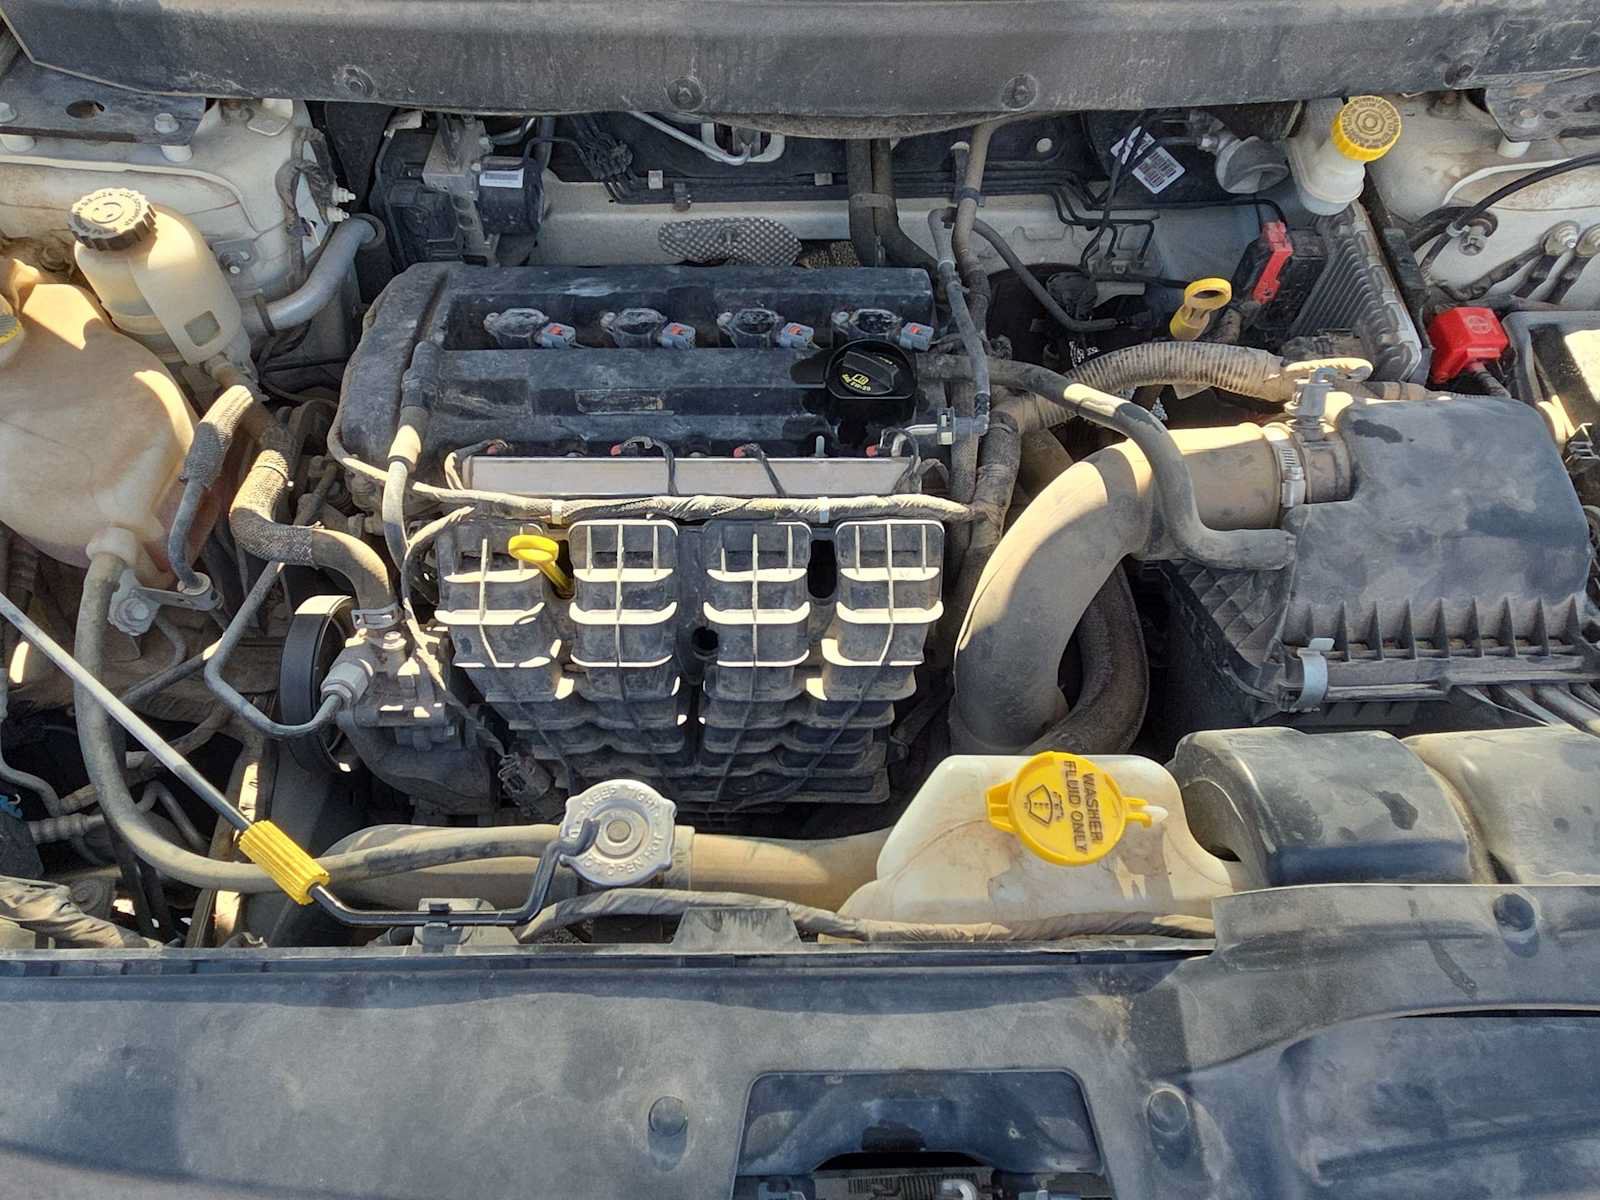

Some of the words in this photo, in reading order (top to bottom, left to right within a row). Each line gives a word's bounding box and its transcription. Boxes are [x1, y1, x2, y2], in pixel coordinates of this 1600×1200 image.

[582, 786, 617, 809] KEEP
[628, 785, 661, 816] TIGHT
[1064, 760, 1081, 809] FLUID
[1083, 772, 1104, 843] WASHER
[607, 856, 643, 876] OPEN
[643, 832, 664, 858] HOT
[1070, 811, 1088, 853] ONLY
